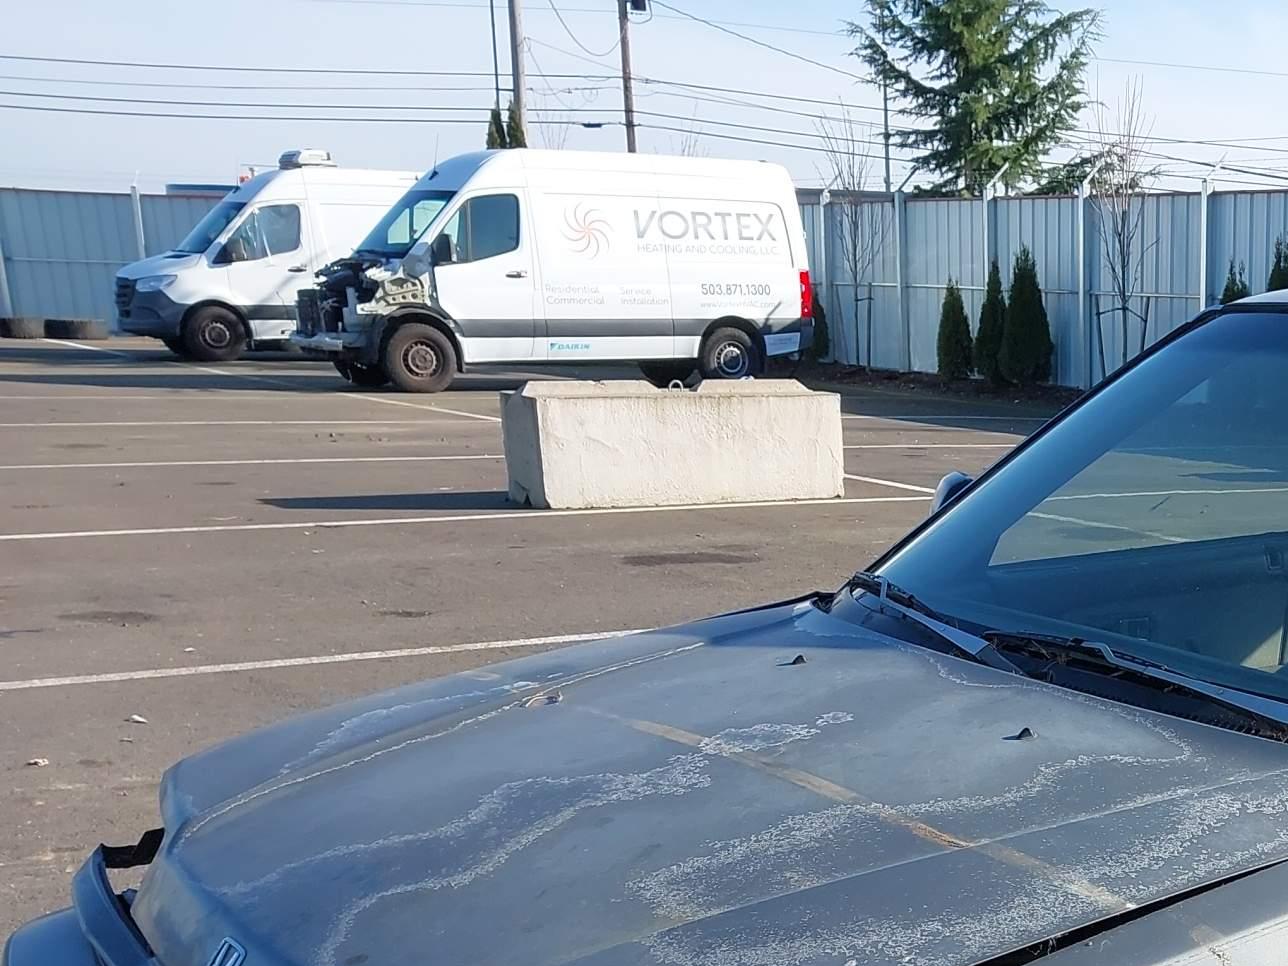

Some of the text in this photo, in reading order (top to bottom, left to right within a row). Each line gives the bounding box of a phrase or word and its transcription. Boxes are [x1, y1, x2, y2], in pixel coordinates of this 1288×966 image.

[633, 209, 777, 241] VORTEX
[637, 243, 683, 253] HEATING
[685, 244, 707, 254] AND
[545, 283, 600, 294] Residential
[701, 283, 771, 296] 503.871.1300
[546, 295, 606, 305] Commercial
[620, 296, 669, 305] Installation
